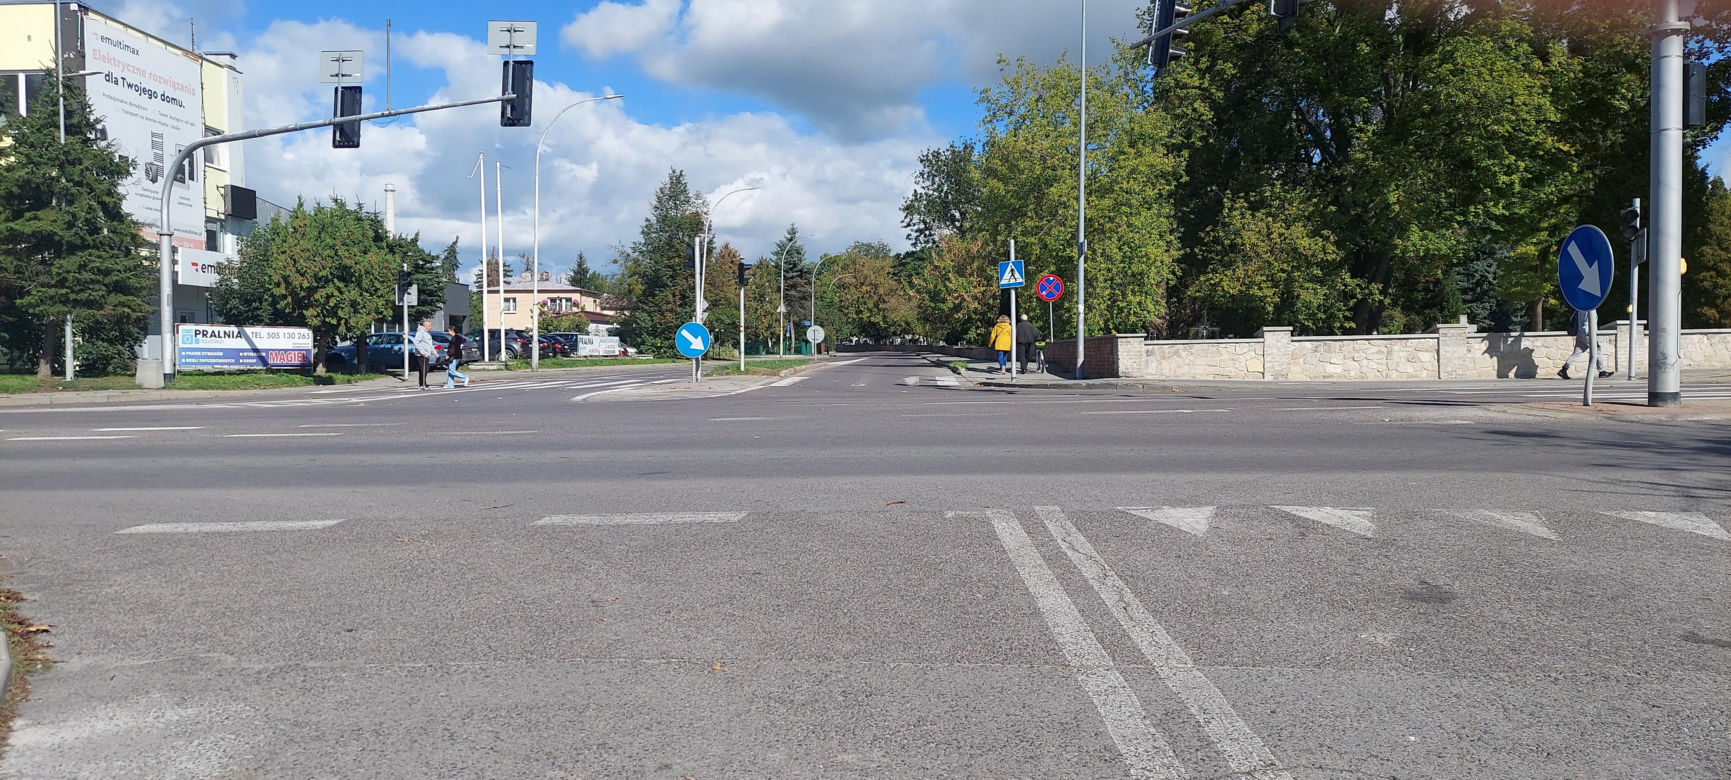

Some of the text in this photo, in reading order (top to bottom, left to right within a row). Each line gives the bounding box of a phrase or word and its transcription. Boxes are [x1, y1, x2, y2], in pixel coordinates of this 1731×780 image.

[101, 34, 140, 57] emultimax
[93, 48, 196, 97] Elektryczne rozwiązania
[104, 71, 186, 109] dla Twojego domu.
[194, 329, 311, 340] PRALNIA TEL. 505 130 265
[268, 351, 308, 364] MAGIEL
